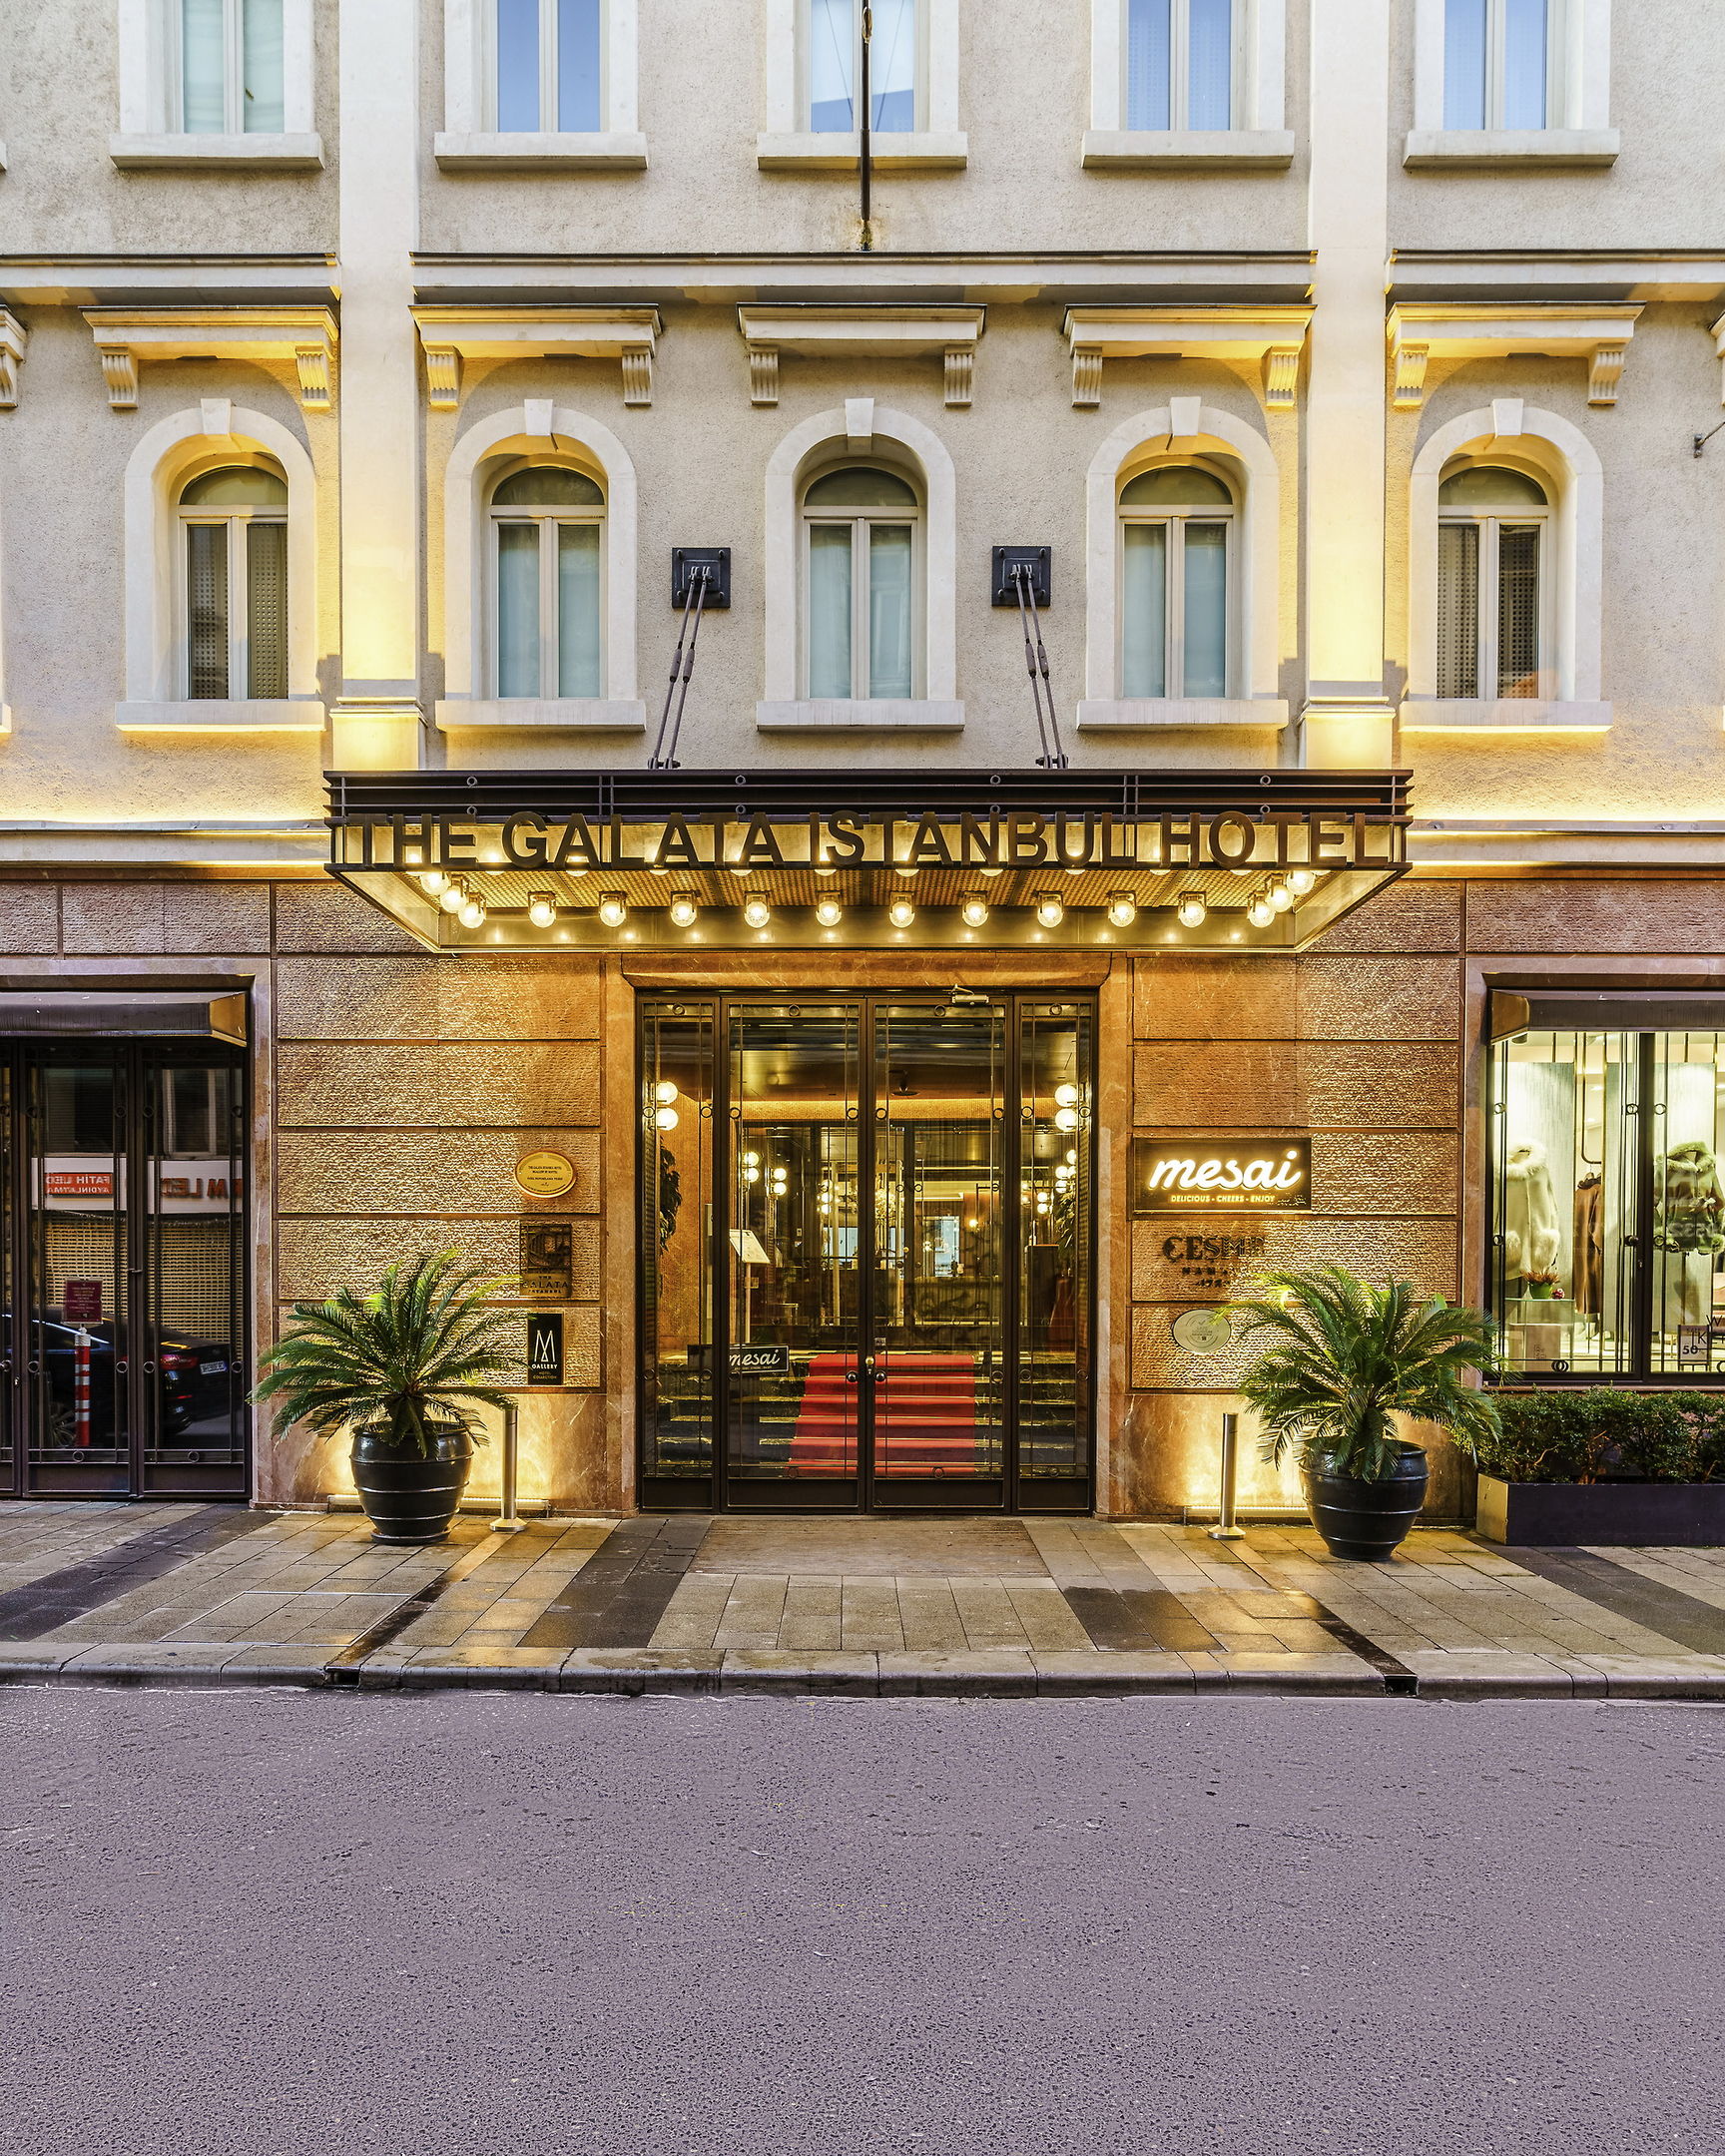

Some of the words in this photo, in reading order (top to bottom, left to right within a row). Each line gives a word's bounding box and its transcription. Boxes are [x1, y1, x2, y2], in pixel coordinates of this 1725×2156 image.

[347, 811, 477, 867] THE
[501, 810, 784, 868] GALATA
[809, 810, 1128, 868] ISTANBUL
[1160, 810, 1390, 868] HOTEL
[1147, 1150, 1303, 1191] mesai
[729, 1348, 781, 1366] mesai
